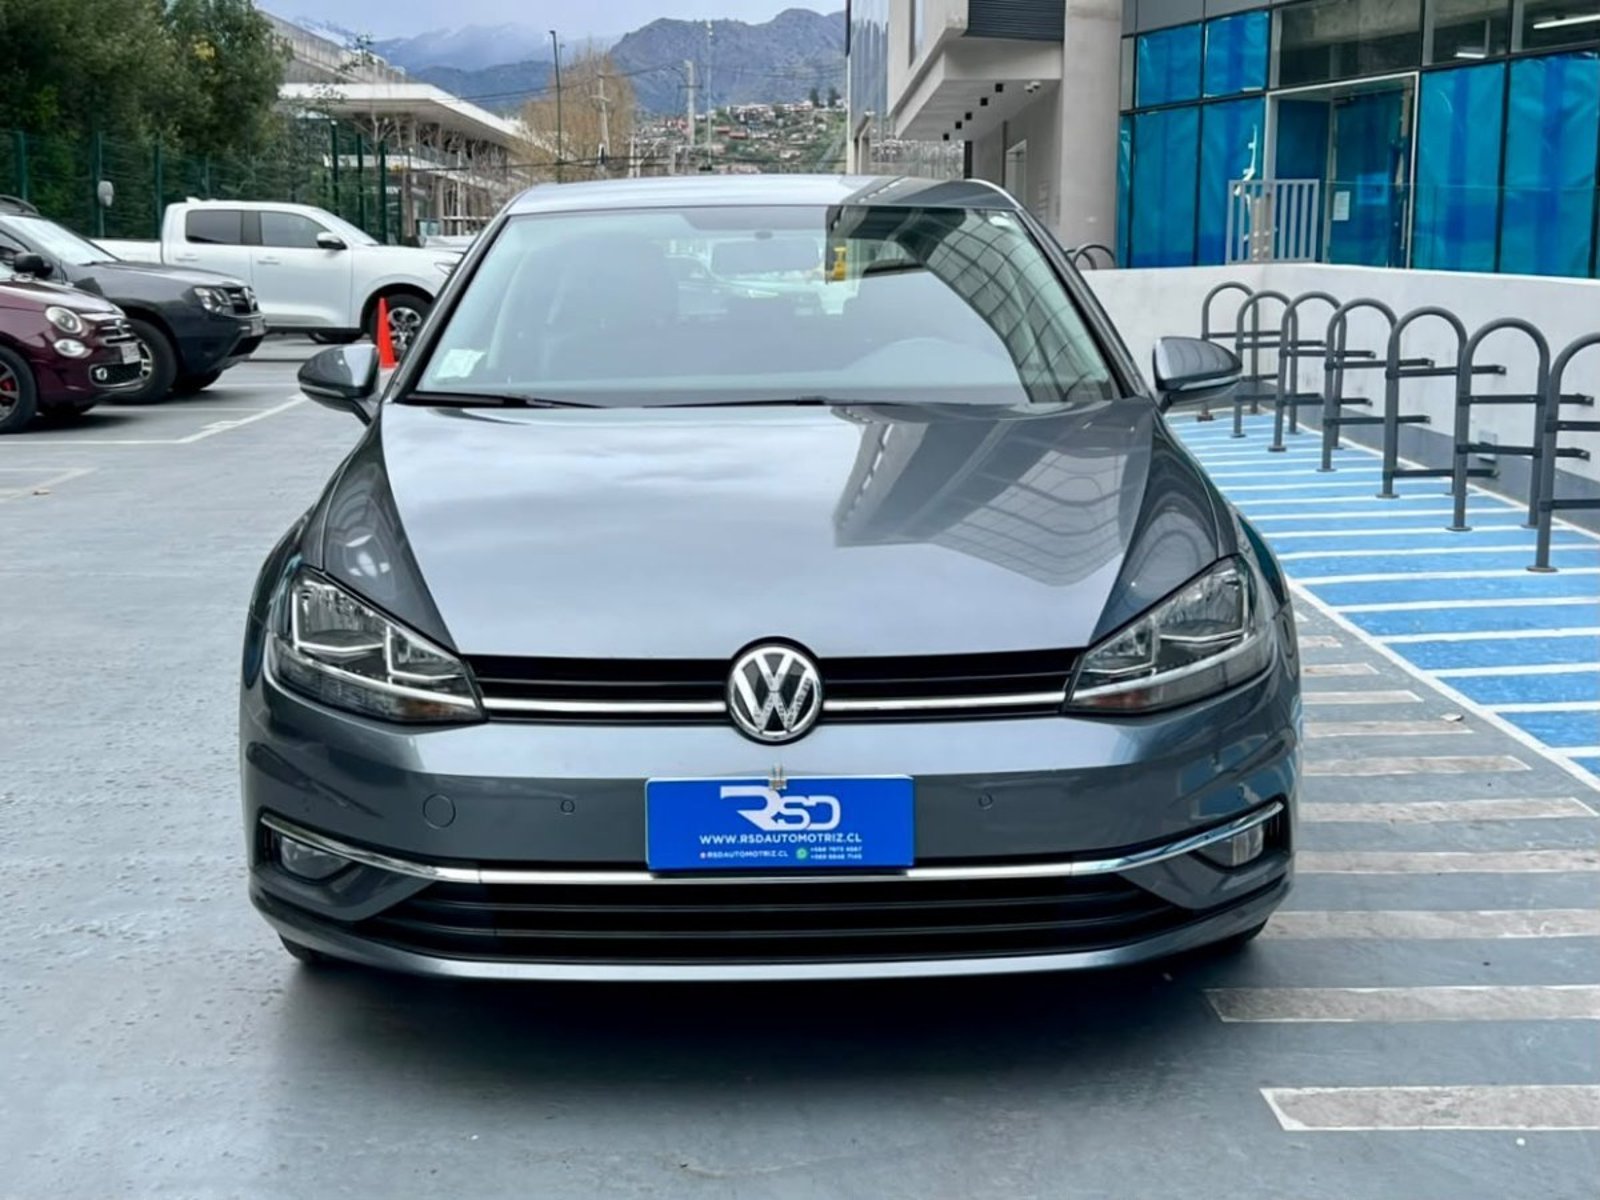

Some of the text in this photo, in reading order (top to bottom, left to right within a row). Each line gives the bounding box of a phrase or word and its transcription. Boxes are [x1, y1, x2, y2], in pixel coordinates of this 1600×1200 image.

[731, 645, 818, 735] VW
[720, 786, 841, 831] RSD
[699, 832, 863, 845] WWW.RSDAUTOMOTRIZ.CL
